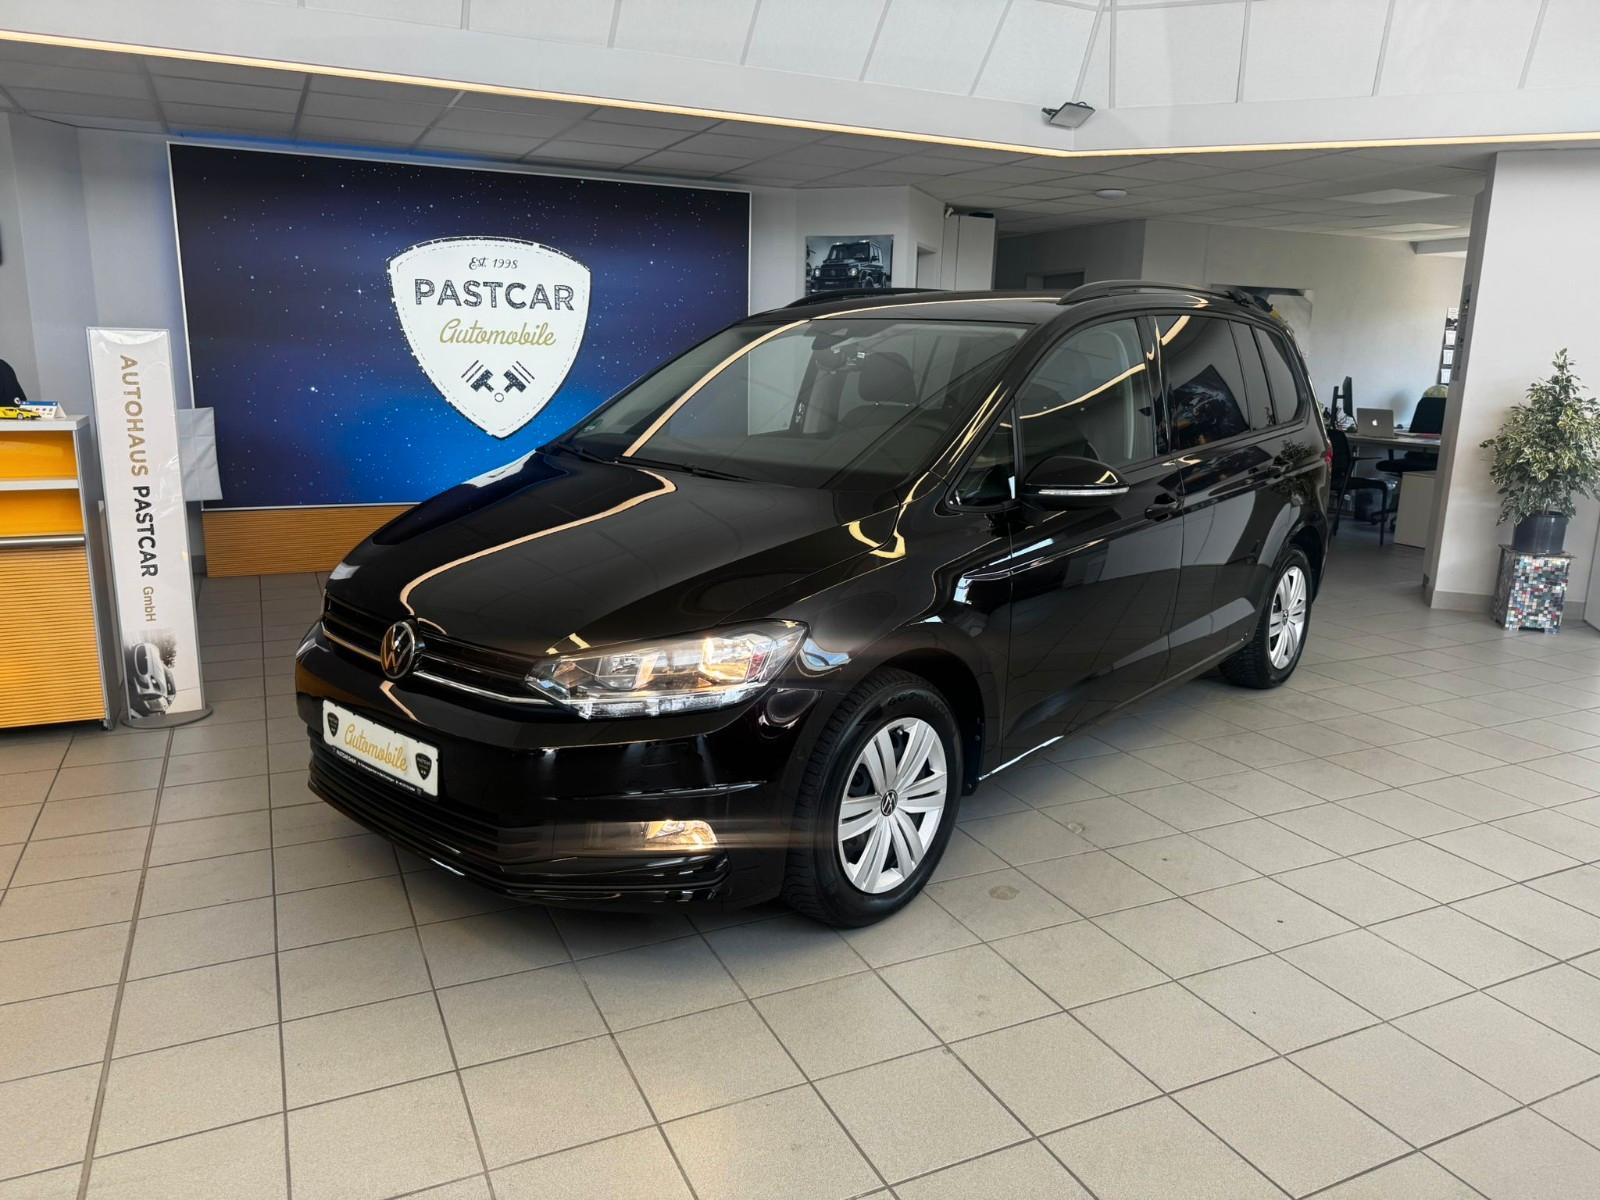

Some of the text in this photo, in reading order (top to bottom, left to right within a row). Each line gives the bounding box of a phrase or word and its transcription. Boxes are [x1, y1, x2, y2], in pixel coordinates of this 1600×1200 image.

[492, 258, 519, 270] 1998
[414, 278, 574, 311] PASTCAR
[439, 318, 556, 346] Automobile
[120, 354, 159, 622] AUTOHAUS PASTCAR GmbH
[344, 723, 408, 772] Automobile
